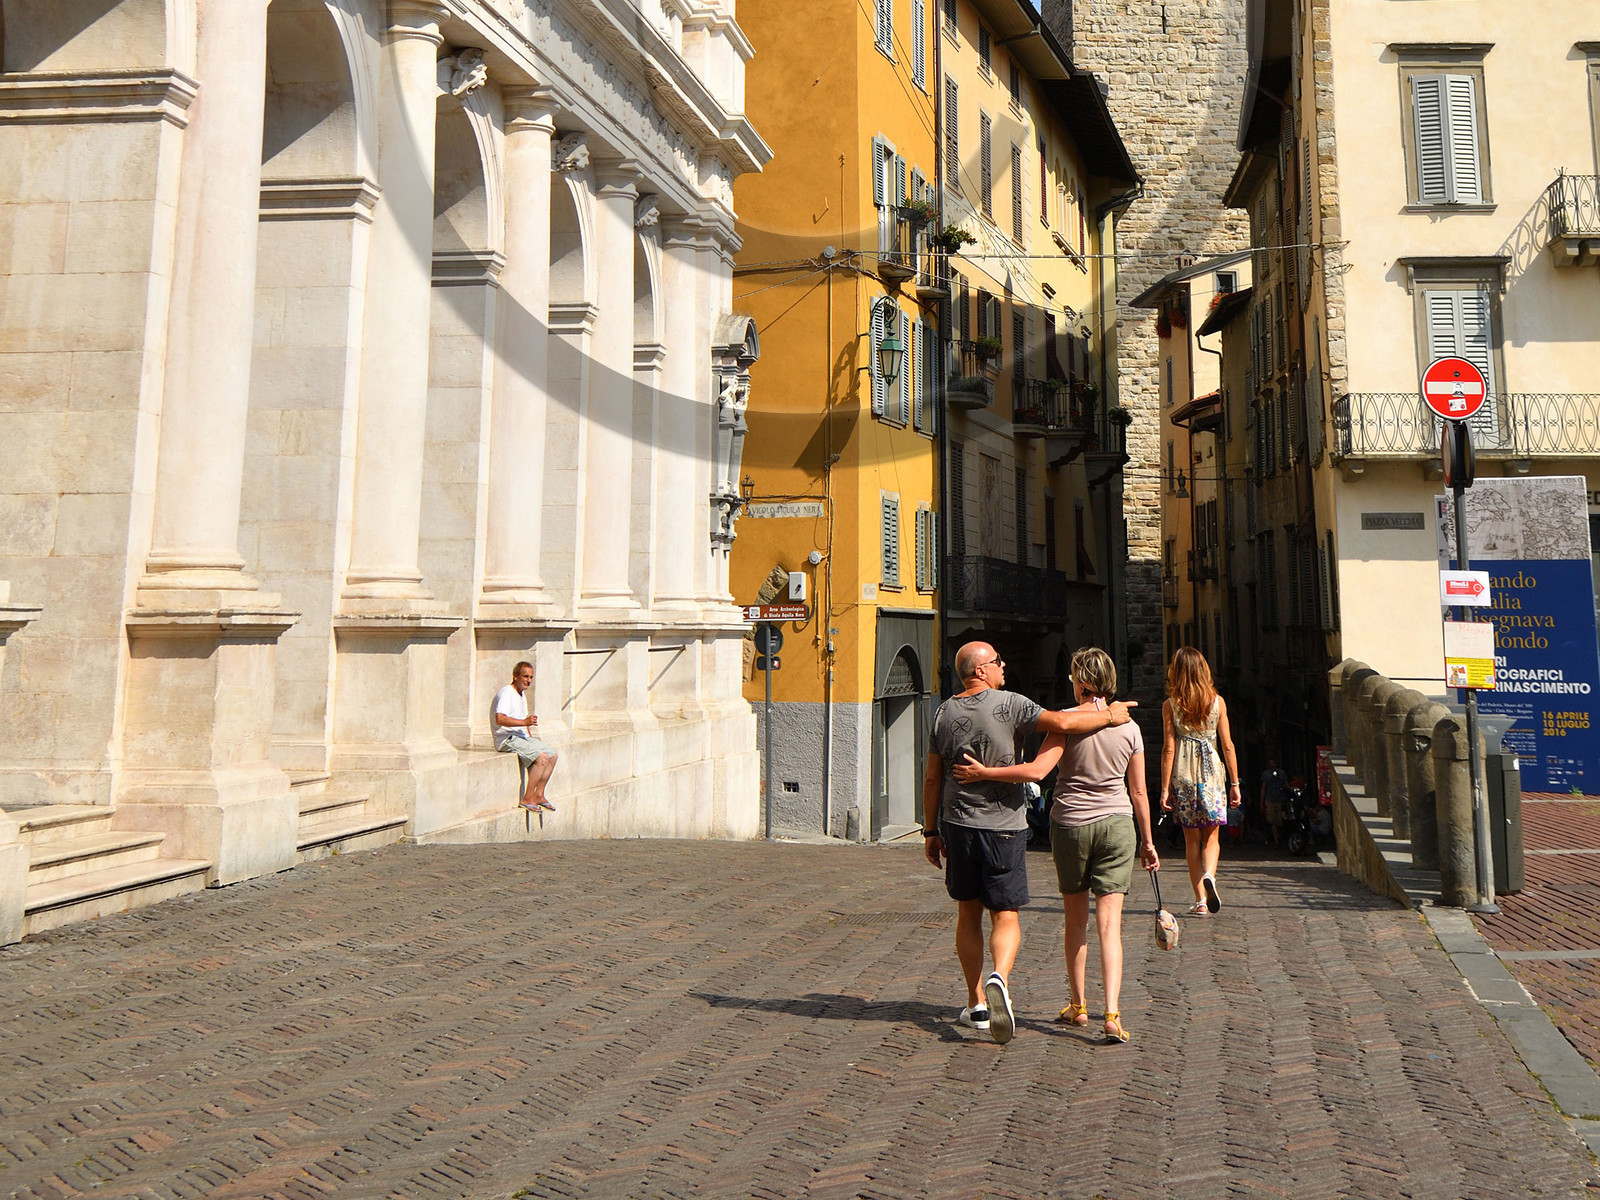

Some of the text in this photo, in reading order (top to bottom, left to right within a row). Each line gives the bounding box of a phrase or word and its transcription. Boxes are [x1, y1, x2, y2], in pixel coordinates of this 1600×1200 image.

[1365, 517, 1390, 526] PIAZZA
[1490, 571, 1537, 588] ando
[1474, 611, 1555, 633] isegnava
[1494, 669, 1563, 681] TOGRAFICI
[1492, 681, 1592, 695] RINASCIMENTO
[1542, 711, 1554, 720] 16
[1556, 711, 1589, 720] APRILE
[1543, 719, 1590, 729] 10 LUGLIO
[1543, 728, 1567, 737] 2016
